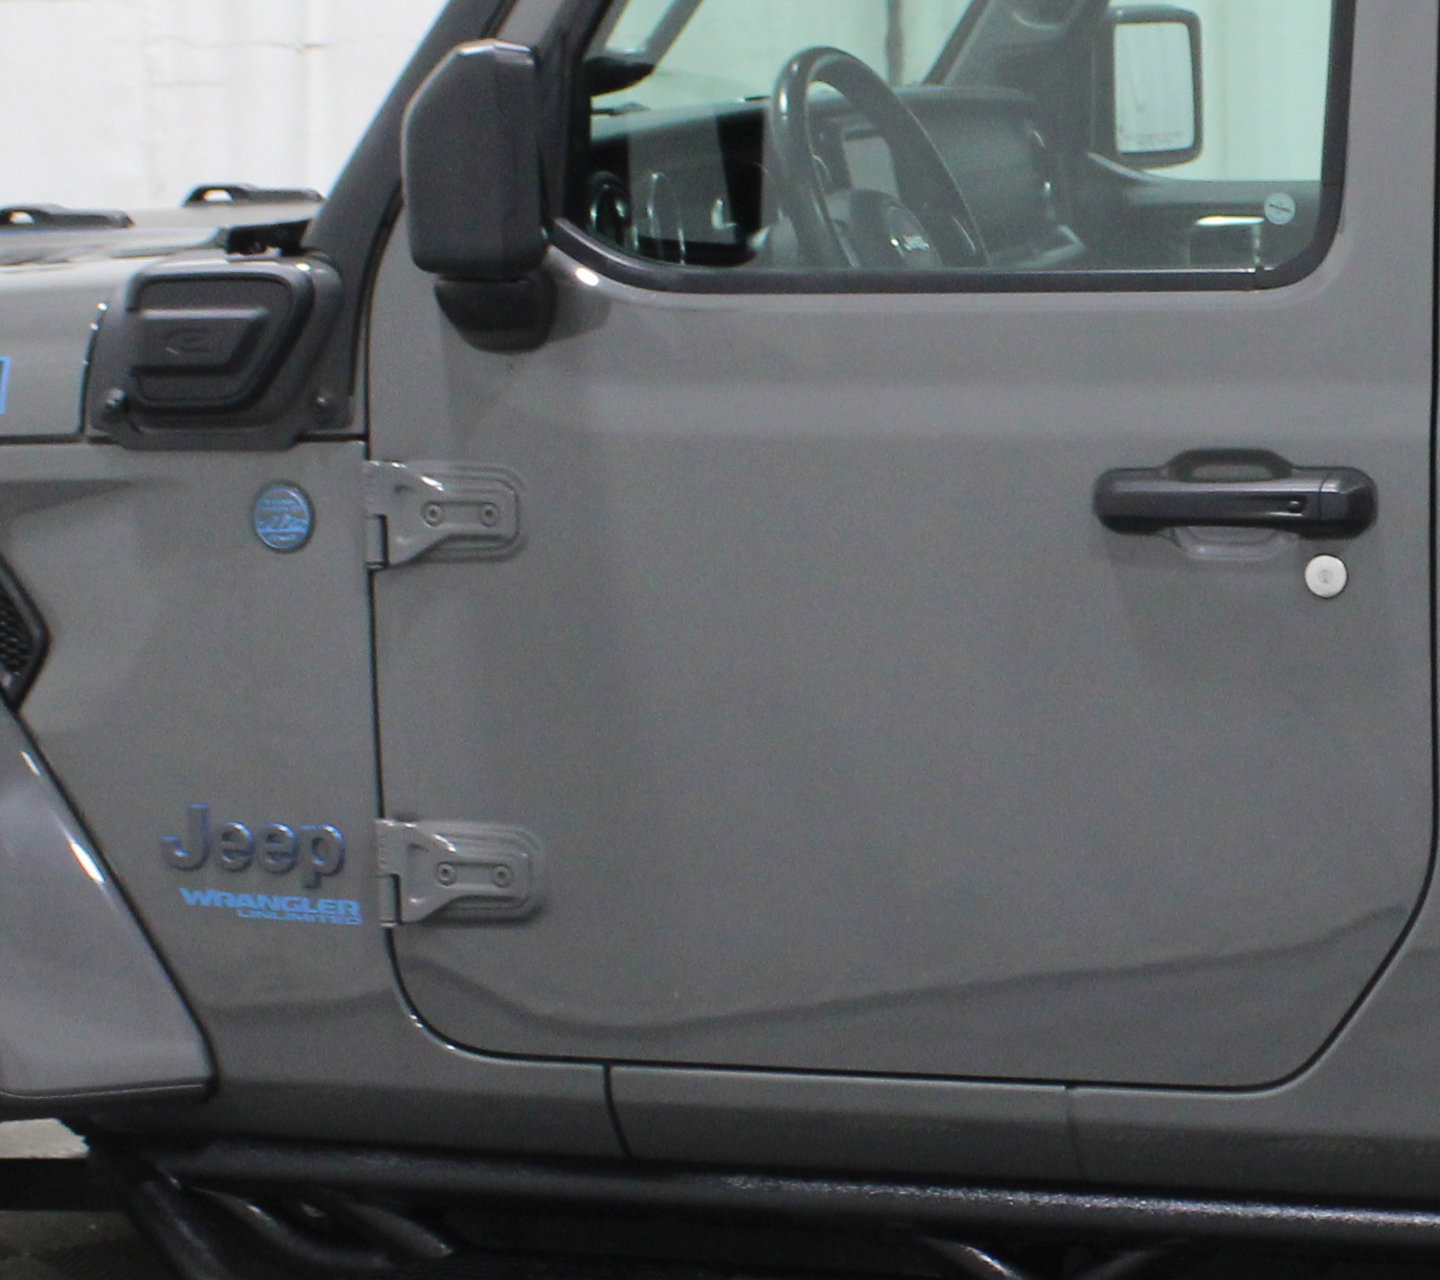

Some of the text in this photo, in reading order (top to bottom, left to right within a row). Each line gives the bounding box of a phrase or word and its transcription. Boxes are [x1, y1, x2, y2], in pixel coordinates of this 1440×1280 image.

[161, 803, 345, 889] Jeep
[179, 887, 361, 917] WRANGLER
[237, 909, 363, 925] UNLIMITED
